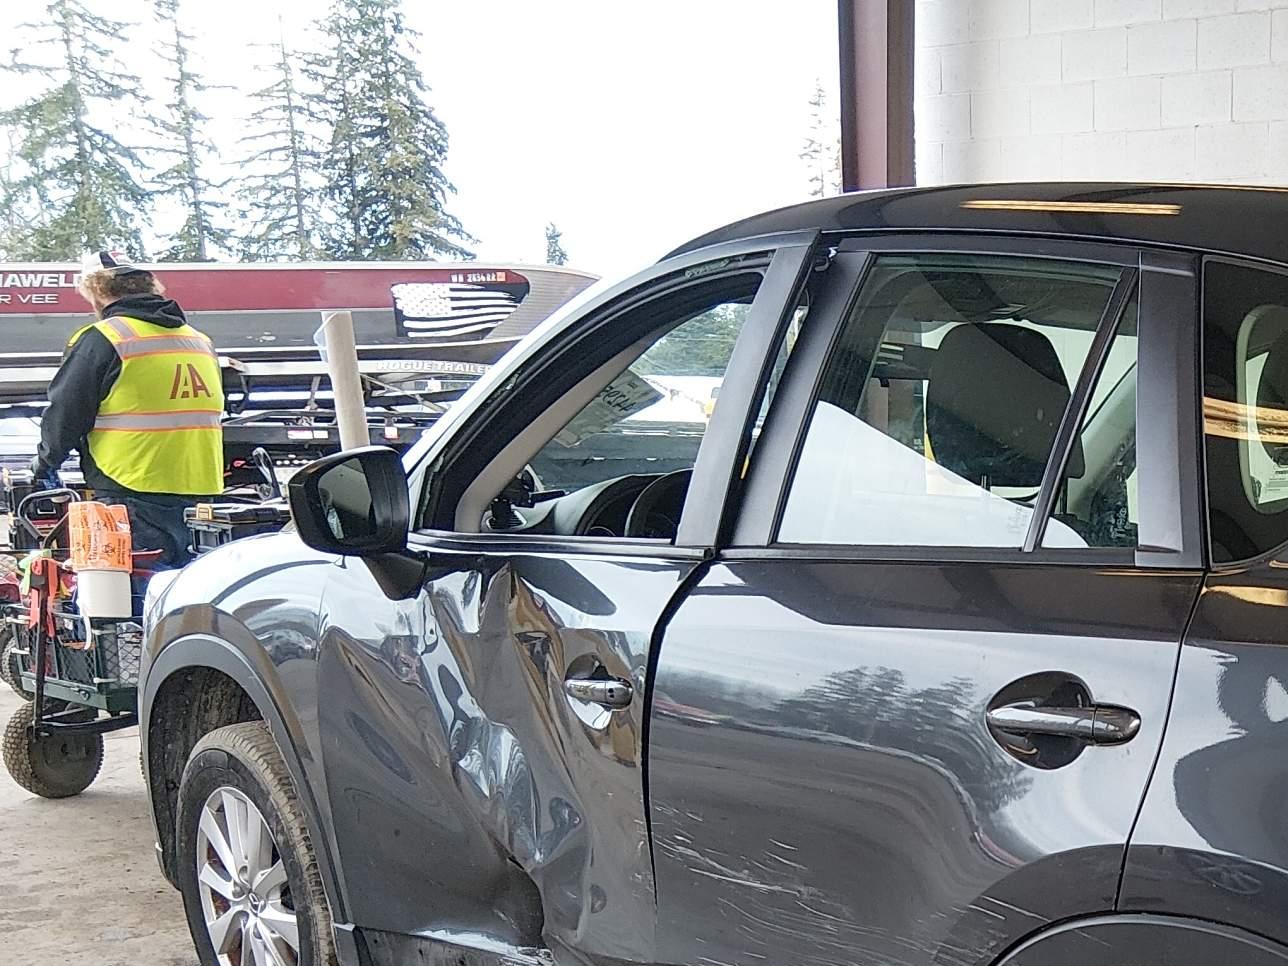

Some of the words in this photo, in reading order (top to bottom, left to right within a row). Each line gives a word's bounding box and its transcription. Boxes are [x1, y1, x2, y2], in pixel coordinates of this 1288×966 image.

[0, 274, 81, 288] AWELD
[18, 293, 59, 304] VEE
[377, 361, 433, 371] ROGUE
